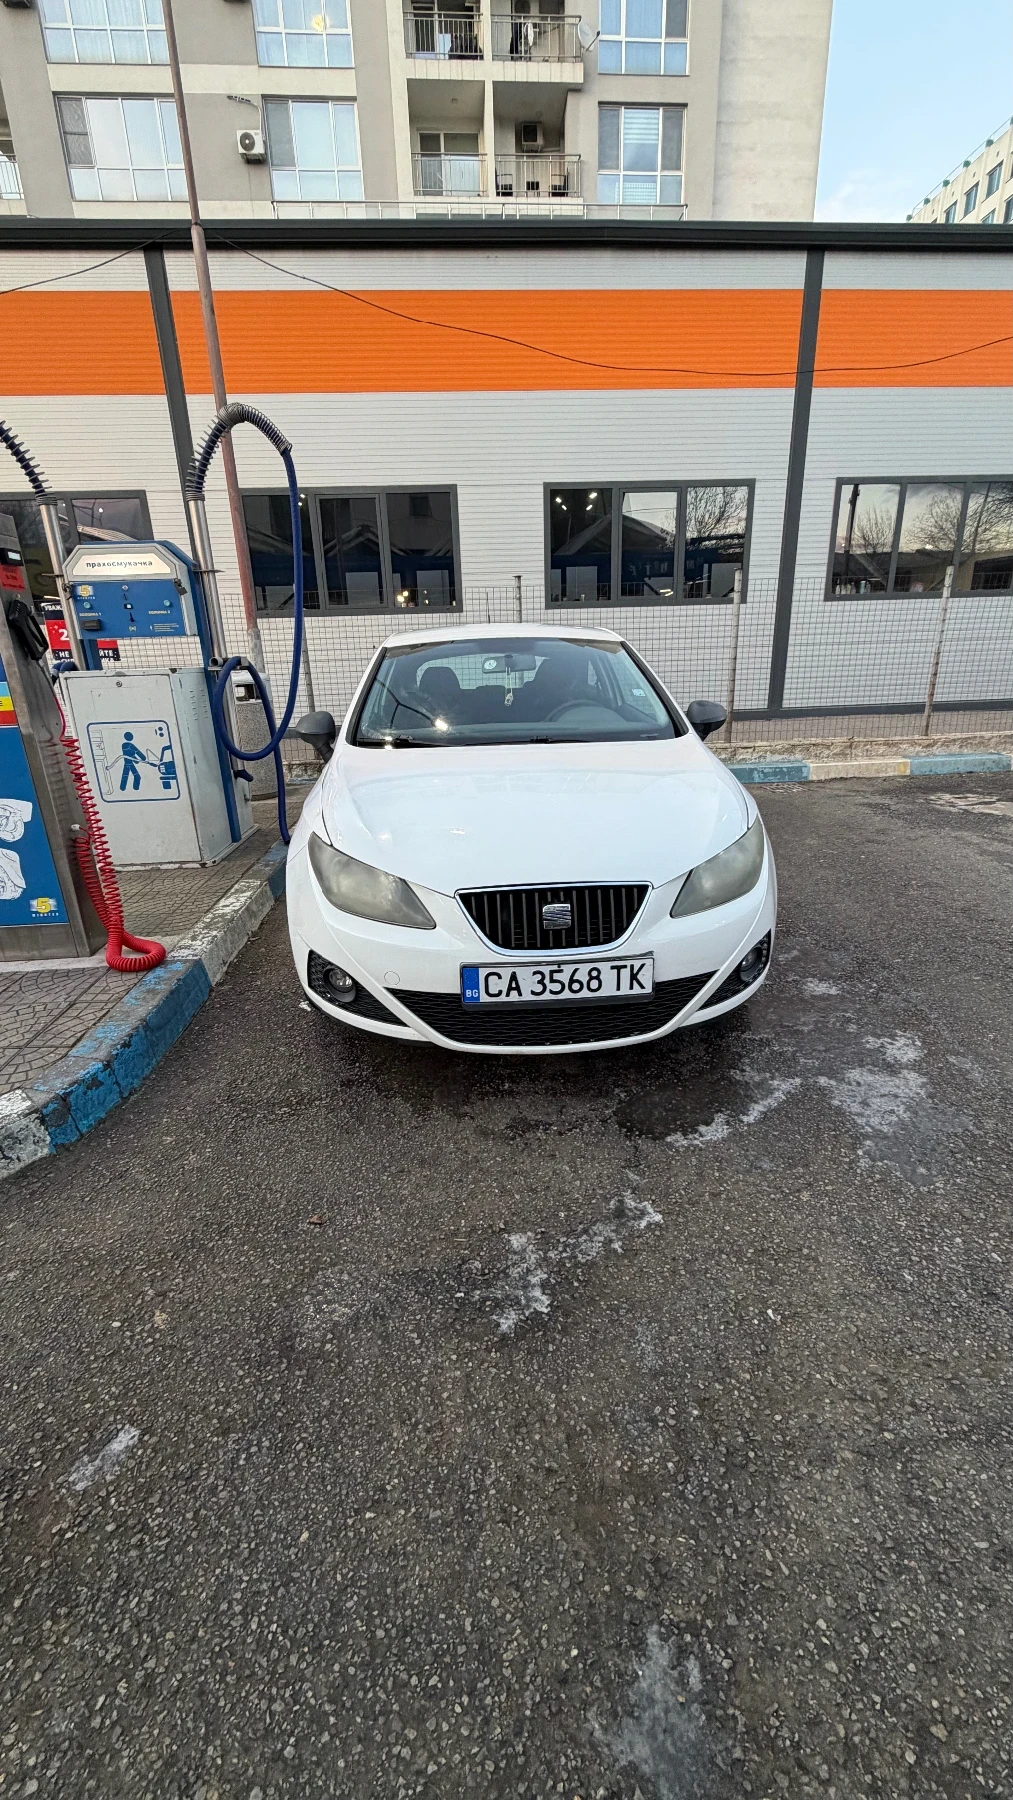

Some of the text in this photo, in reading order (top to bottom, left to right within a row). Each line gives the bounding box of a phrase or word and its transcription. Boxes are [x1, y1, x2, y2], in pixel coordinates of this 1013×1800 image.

[86, 560, 153, 569] прахосмукачка
[36, 897, 51, 913] 5
[484, 963, 647, 997] CA 3568 TK
[465, 989, 479, 998] BG
